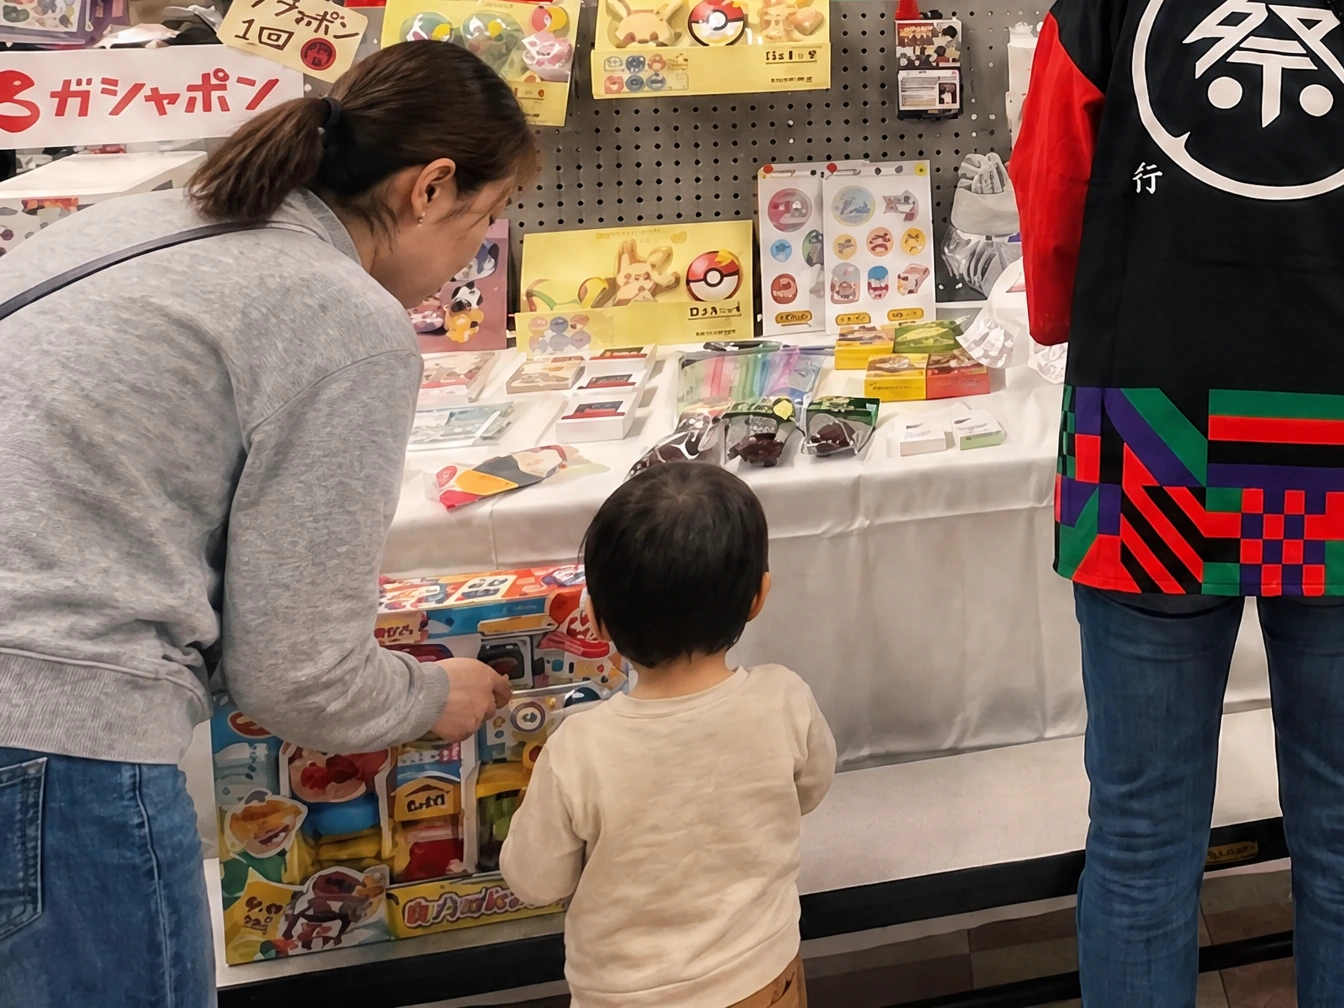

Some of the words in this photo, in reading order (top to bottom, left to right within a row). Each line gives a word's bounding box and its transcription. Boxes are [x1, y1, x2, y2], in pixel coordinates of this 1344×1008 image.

[50, 67, 280, 117] ガシャポン
[1132, 161, 1163, 195] 行
